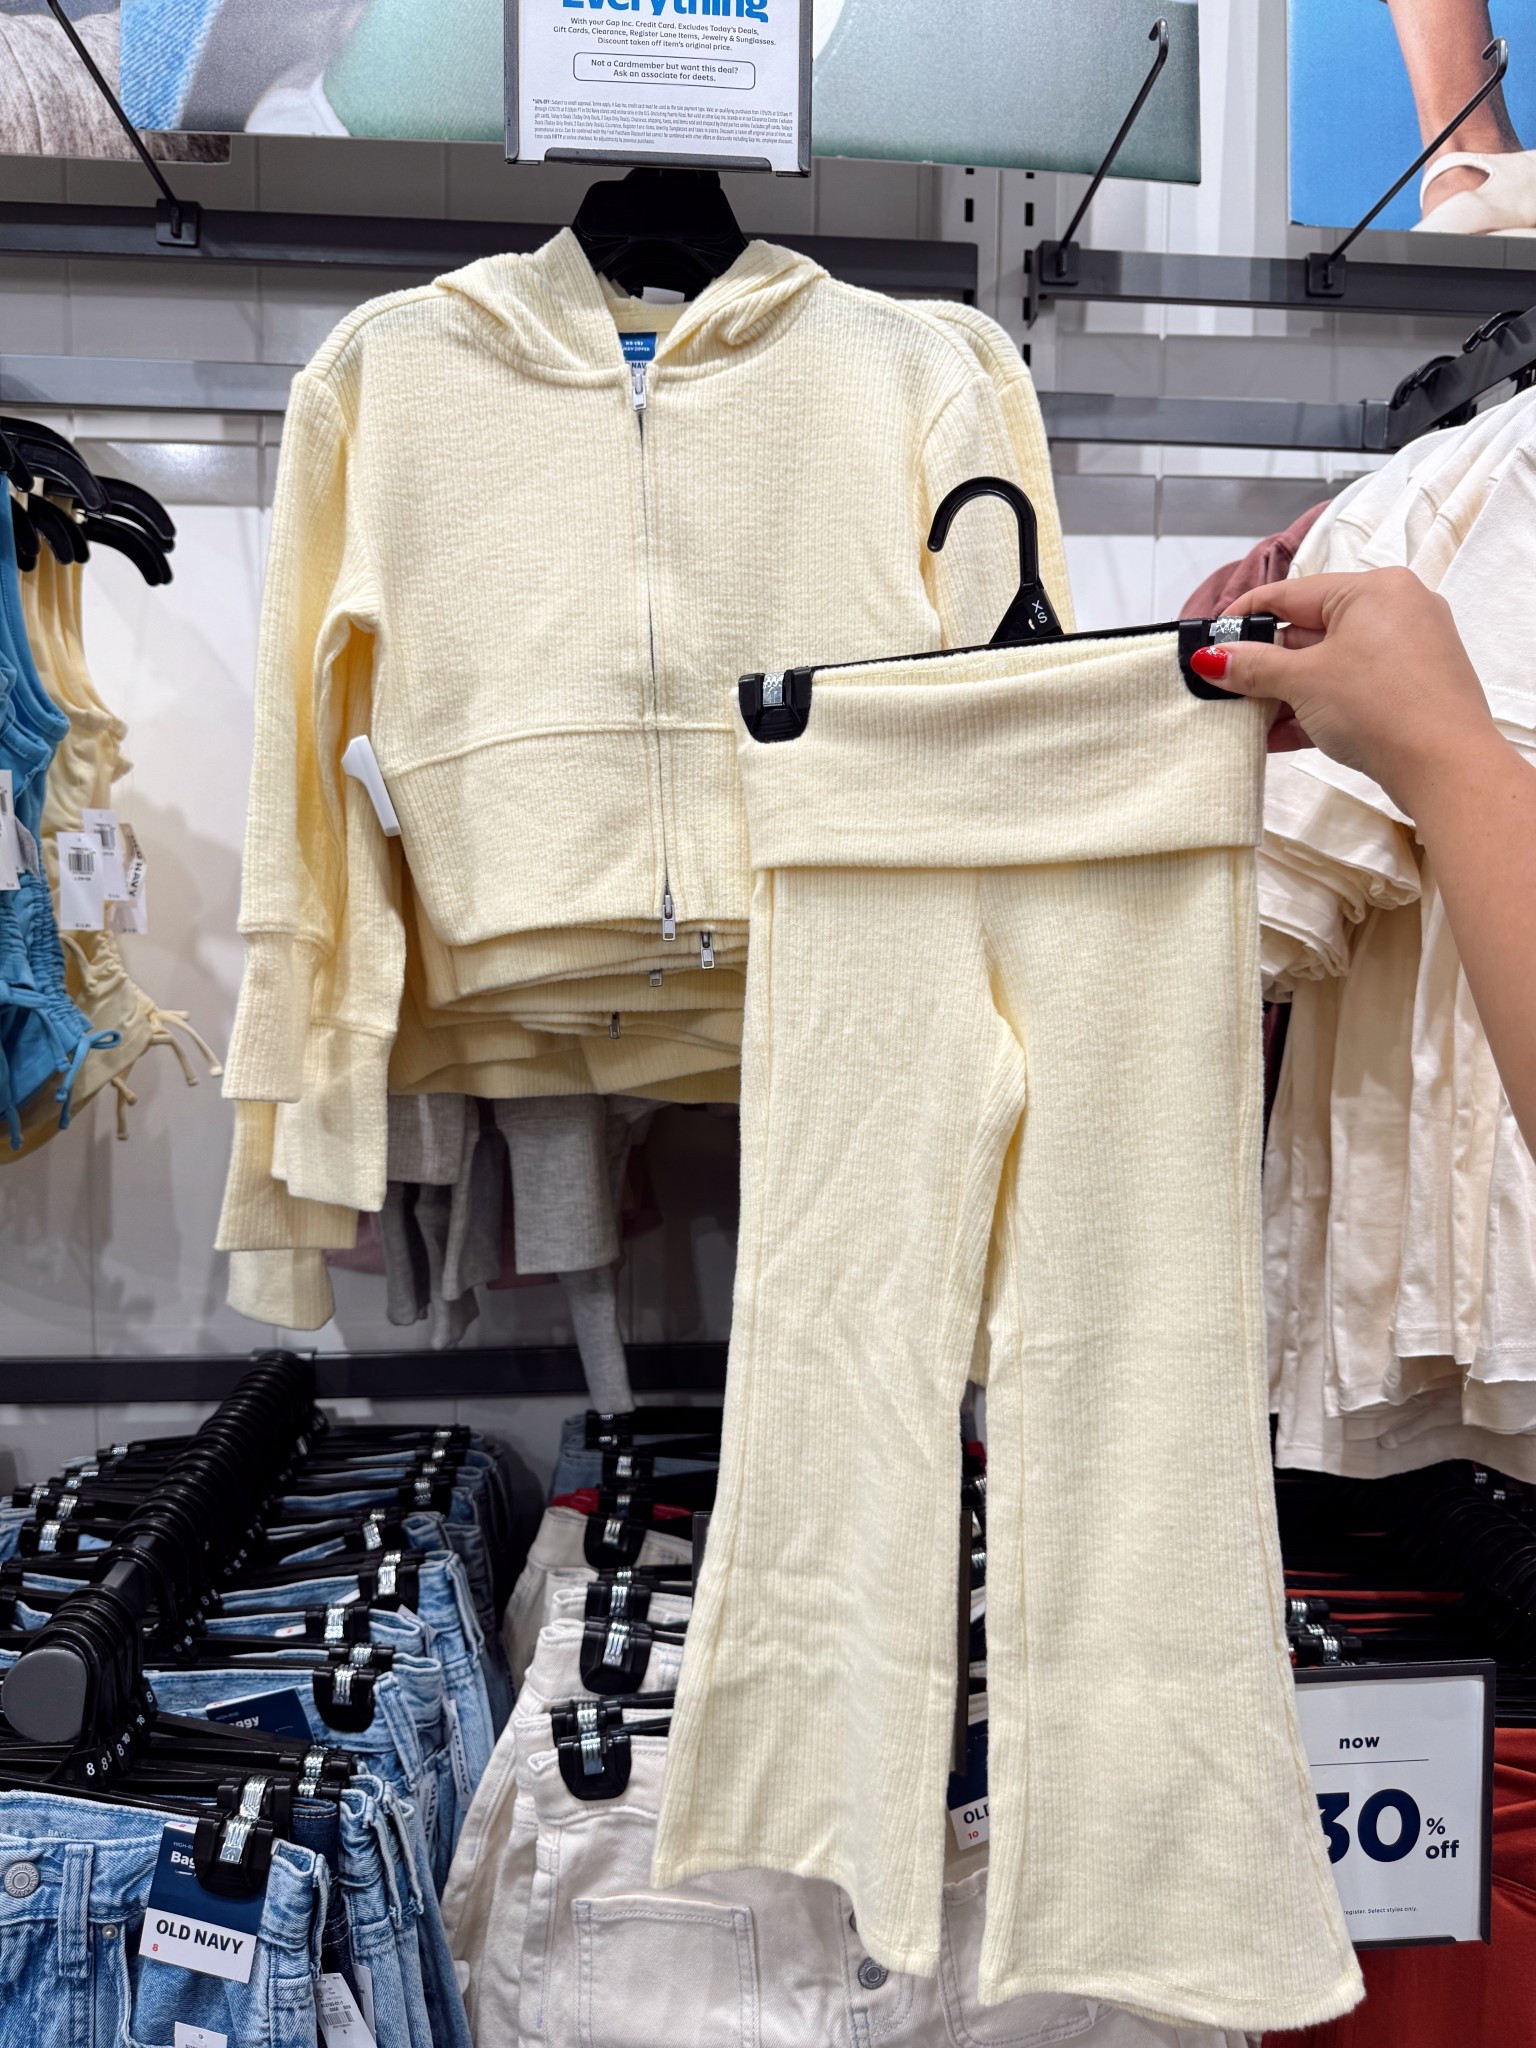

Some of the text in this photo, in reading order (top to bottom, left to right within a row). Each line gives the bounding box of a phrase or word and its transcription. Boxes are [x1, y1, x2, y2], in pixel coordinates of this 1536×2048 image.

[678, 23, 708, 31] Excludes
[738, 27, 759, 35] Deals,
[568, 27, 589, 35] Cards,
[592, 28, 627, 36] Clearance,
[660, 31, 677, 40] Lane
[678, 32, 699, 40] Items,
[701, 34, 727, 42] Jewelry
[736, 36, 776, 45] Sunglasses.
[613, 61, 664, 69] Cardmember
[718, 66, 738, 74] deal?
[692, 73, 715, 81] deets.
[1032, 600, 1048, 624] XS
[128, 862, 142, 897] NAVY
[146, 1691, 153, 1702] 8
[1339, 1736, 1380, 1749] now
[117, 1743, 124, 1756] 8
[86, 1762, 95, 1776] 8
[102, 1758, 108, 1770] 8
[1316, 1788, 1446, 1864] 30 %
[968, 1830, 979, 1840] 10
[1426, 1840, 1460, 1859] off
[170, 1850, 195, 1868] Bag
[156, 1920, 243, 1954] OLD NAVY
